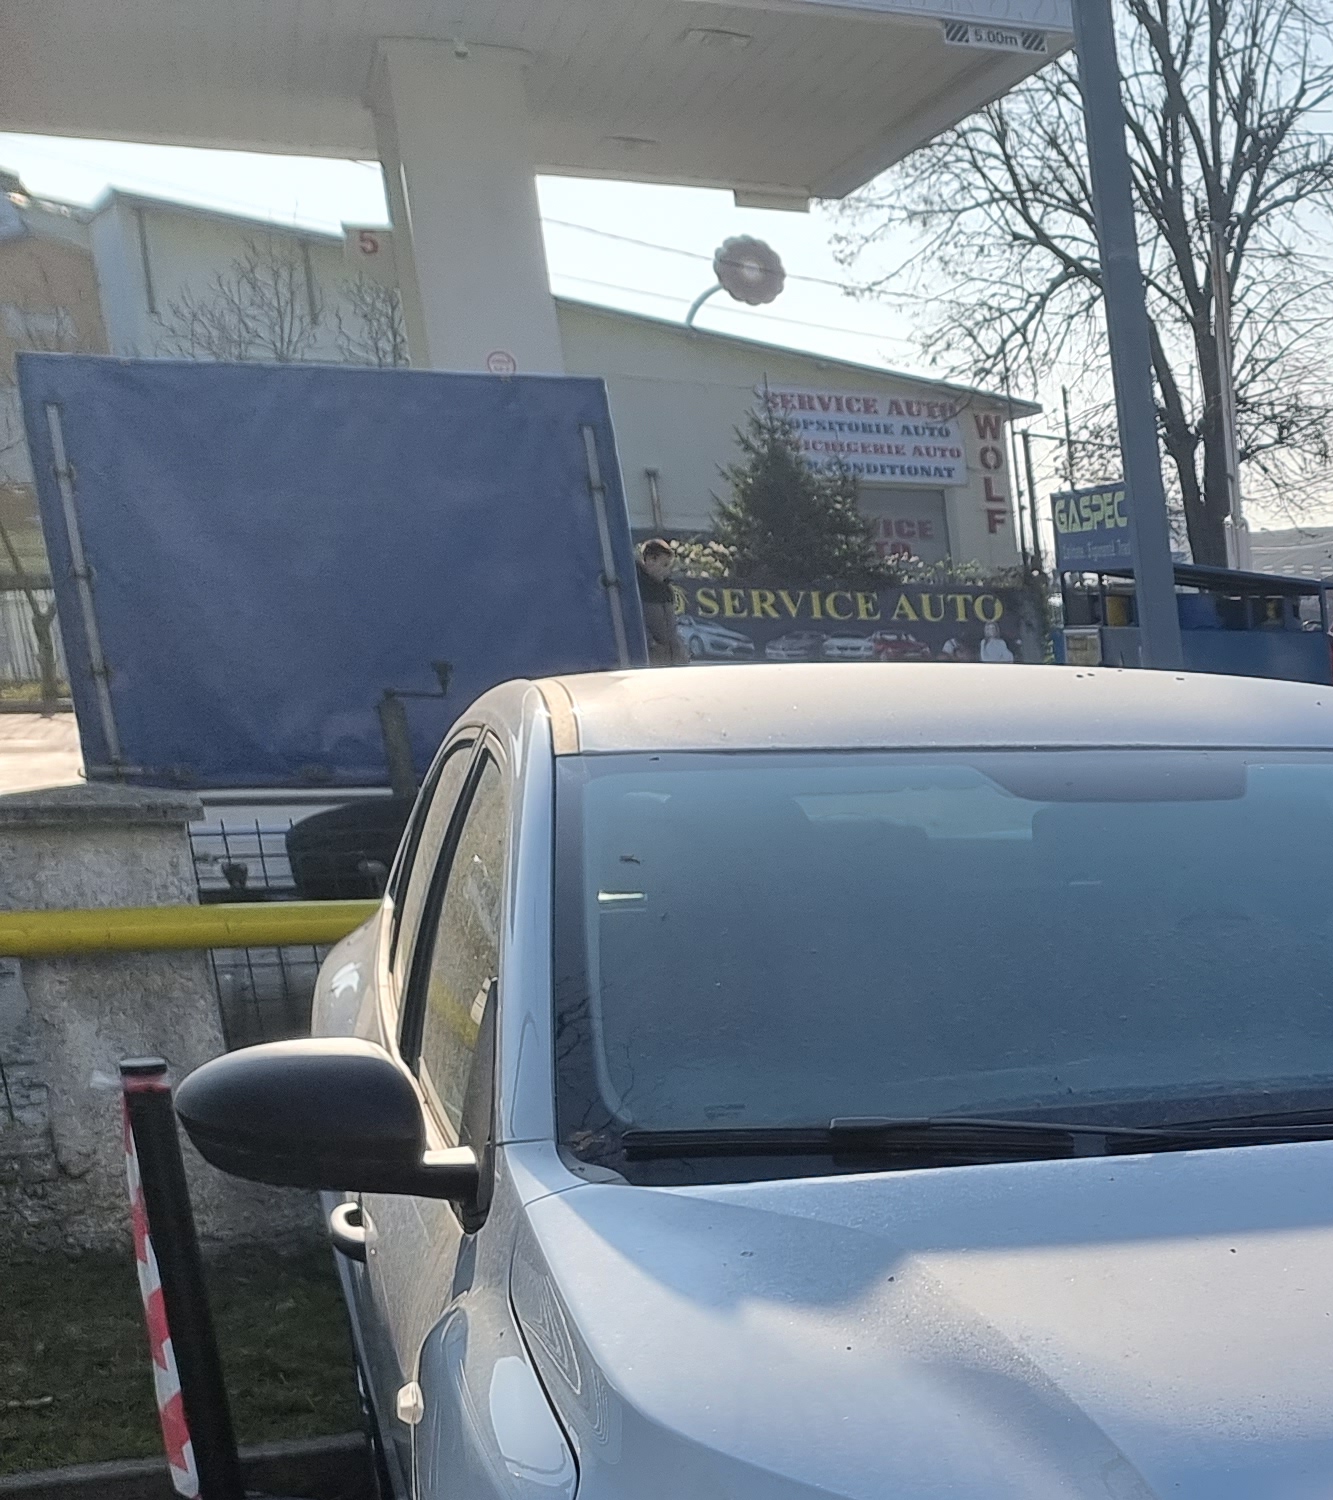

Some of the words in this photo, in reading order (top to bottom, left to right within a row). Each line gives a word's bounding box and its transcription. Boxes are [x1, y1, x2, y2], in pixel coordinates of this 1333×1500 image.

[974, 29, 1018, 47] 5.00m
[359, 231, 379, 254] 5
[767, 391, 879, 416] SERVICE
[887, 399, 961, 421] AUTO
[901, 425, 952, 438] AUTO
[911, 445, 963, 460] AUTO
[973, 414, 1007, 534] WOLF
[1054, 490, 1129, 534] GASPEC
[696, 587, 882, 621] SERVICE
[890, 592, 1004, 623] AUTO
